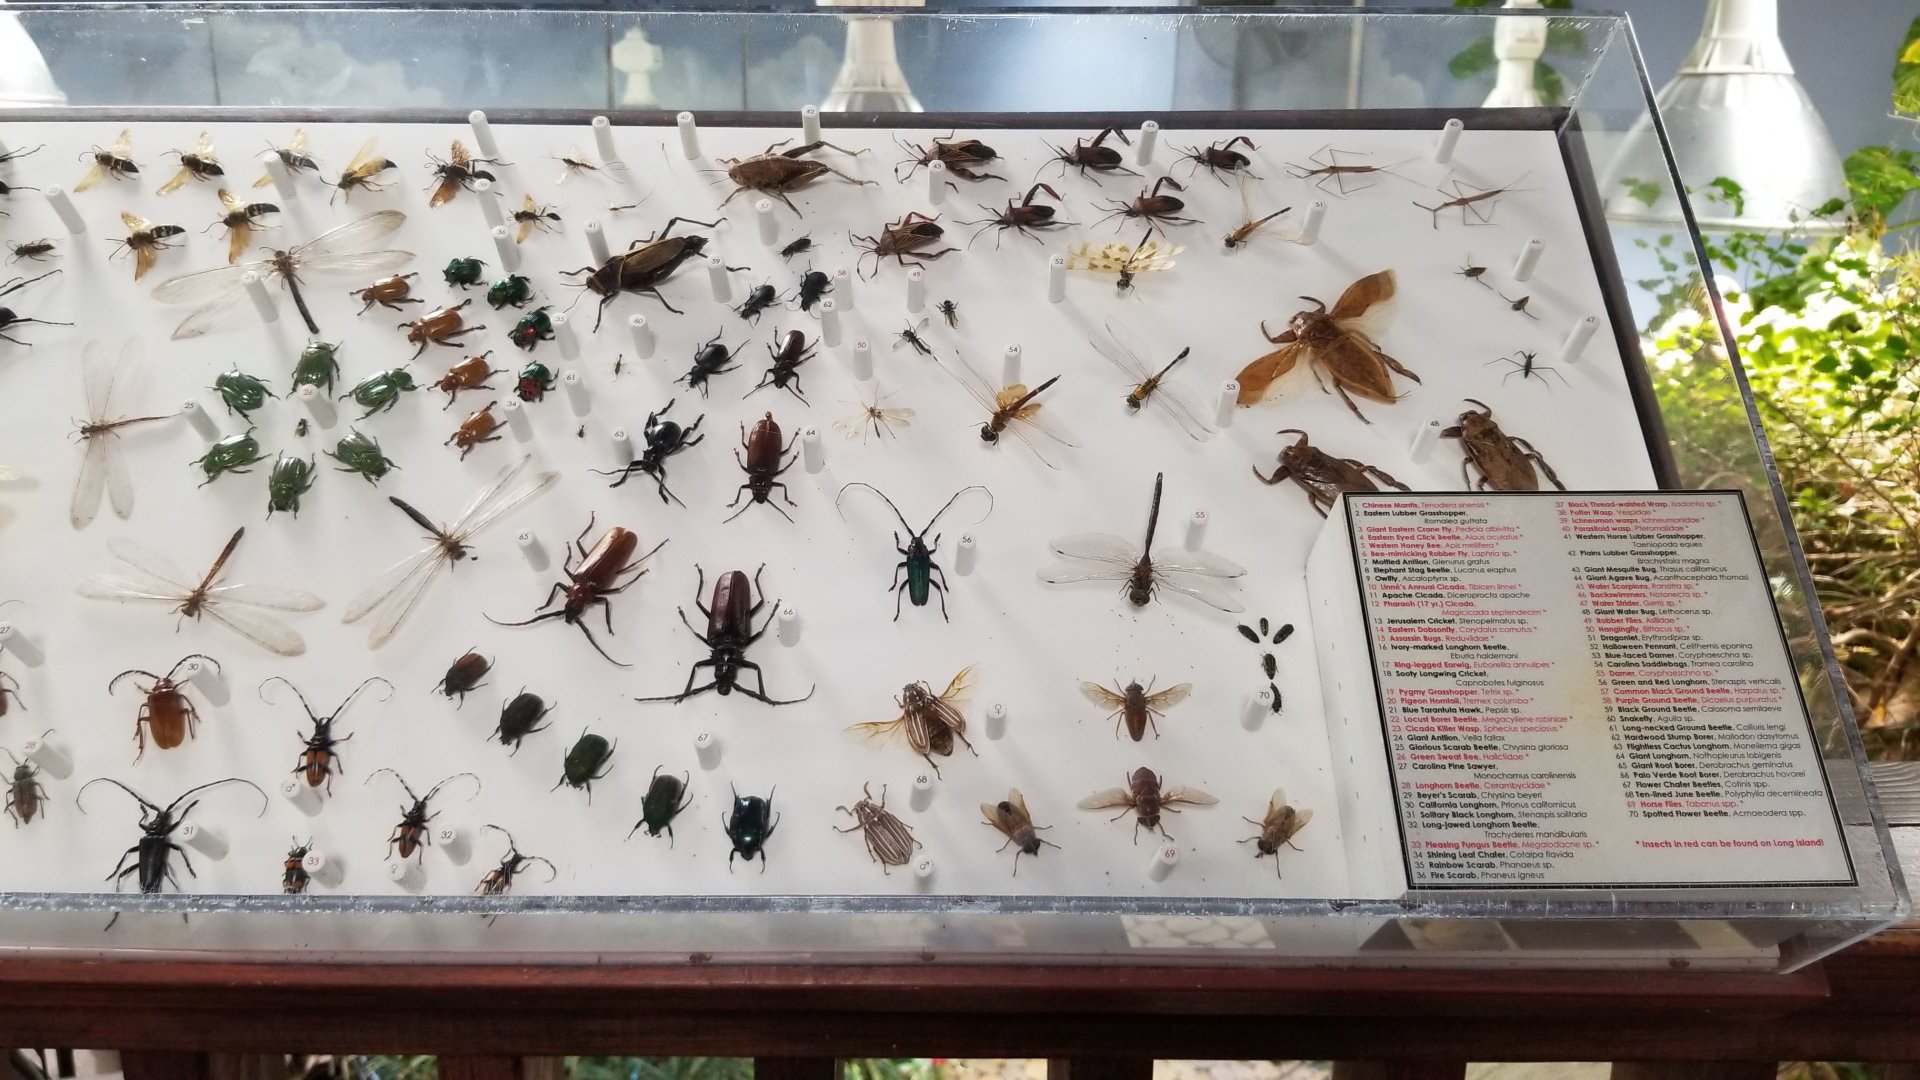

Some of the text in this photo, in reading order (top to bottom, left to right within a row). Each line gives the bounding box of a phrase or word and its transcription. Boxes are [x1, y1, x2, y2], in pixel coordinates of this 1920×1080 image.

[1472, 821, 1510, 829] Longhorn
[184, 826, 193, 834] 31
[1773, 840, 1794, 848] Long
[1165, 850, 1175, 858] 69
[1427, 851, 1456, 860] Shining
[308, 857, 319, 865] 33
